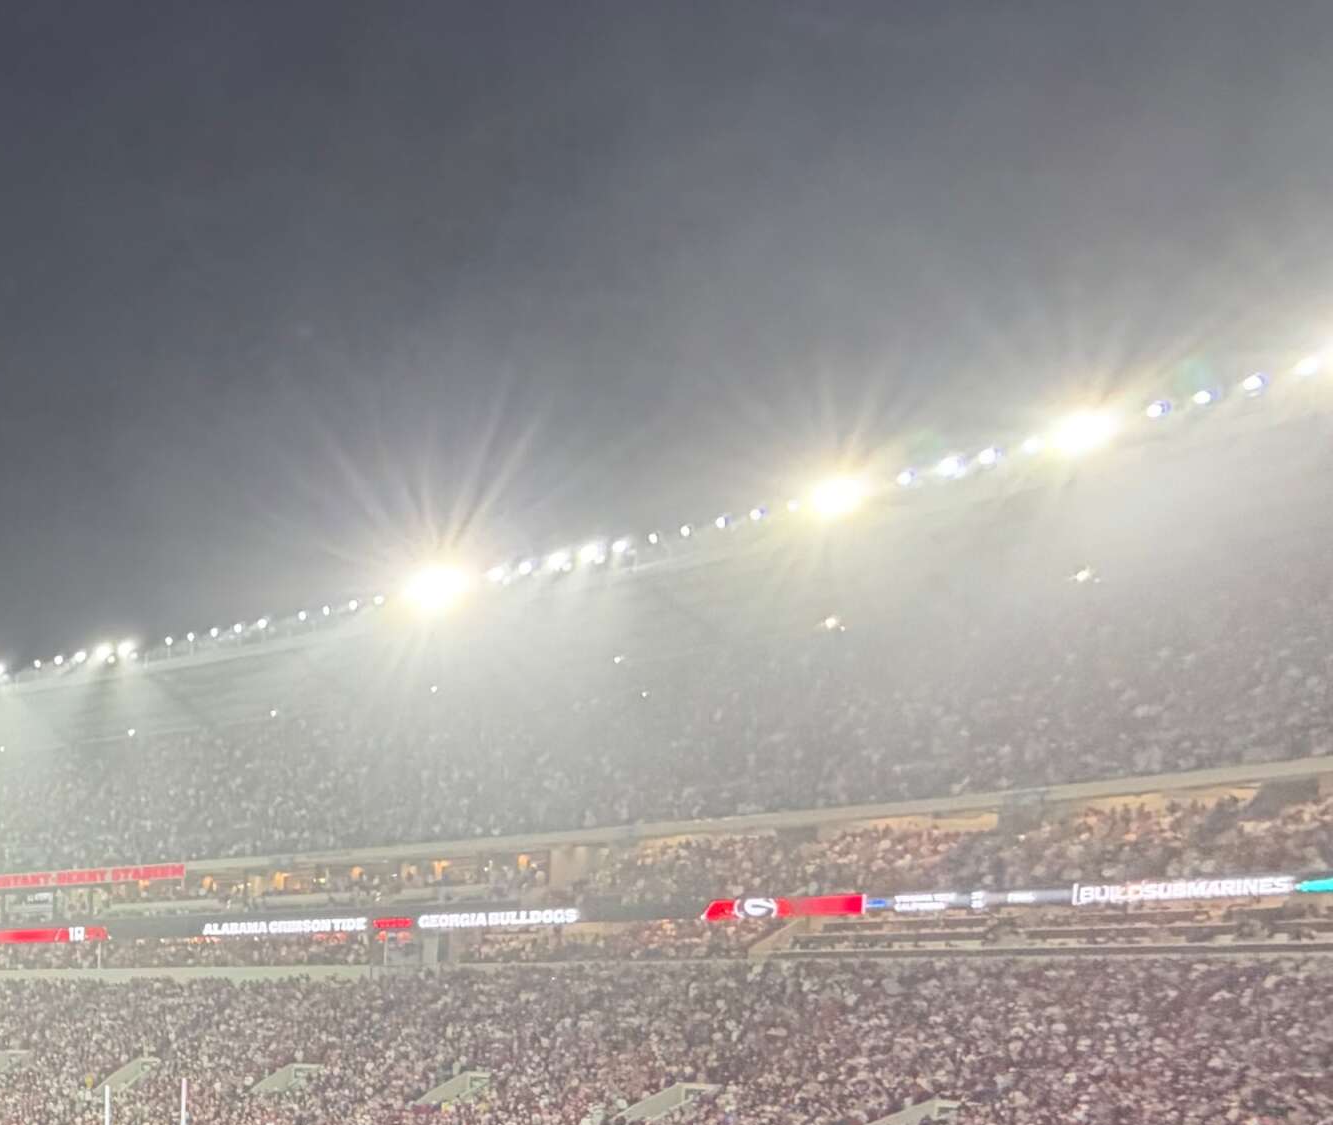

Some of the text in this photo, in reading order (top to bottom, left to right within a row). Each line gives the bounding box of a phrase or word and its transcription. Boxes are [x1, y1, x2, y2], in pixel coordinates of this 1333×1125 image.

[202, 917, 367, 936] ALABAMA CRIMSON TIDE
[417, 908, 579, 929] GEORGIA BULLDOGS
